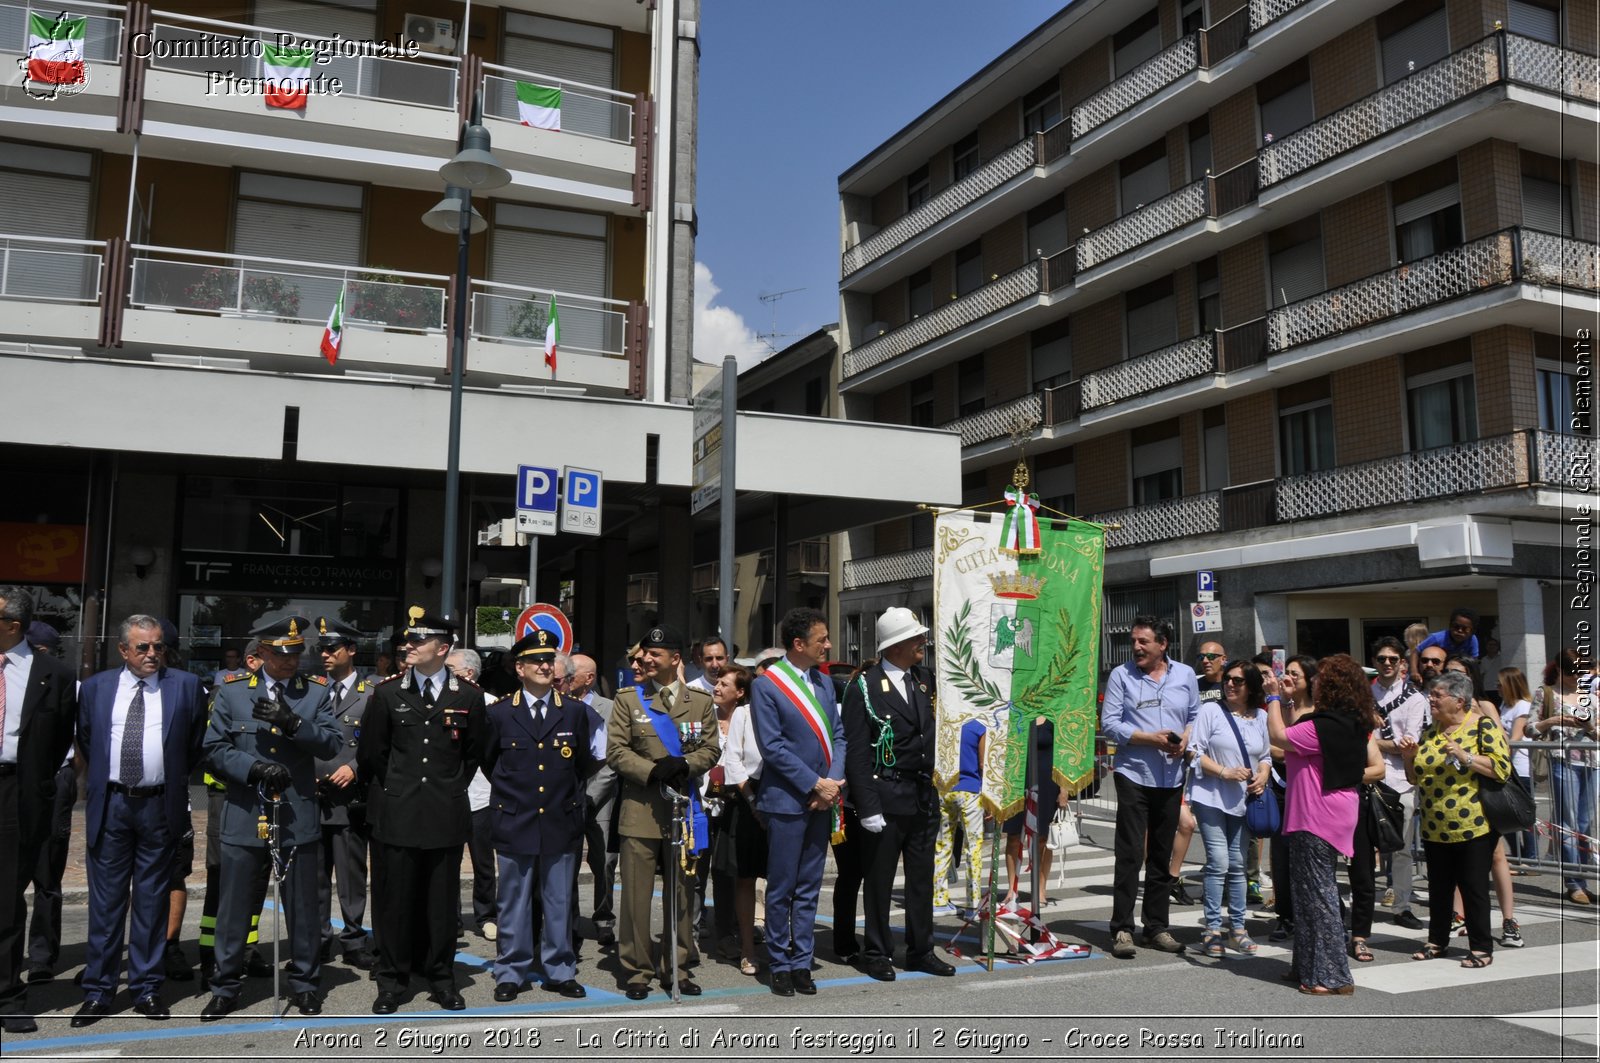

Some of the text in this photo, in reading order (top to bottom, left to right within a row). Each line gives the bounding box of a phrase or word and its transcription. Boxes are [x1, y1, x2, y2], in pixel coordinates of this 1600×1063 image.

[524, 469, 550, 506] P
[573, 476, 592, 502] P
[185, 560, 233, 582] TF
[242, 562, 393, 580] FRANCESCO TRAVAGLIO
[1200, 572, 1210, 590] P
[1196, 621, 1204, 631] P
